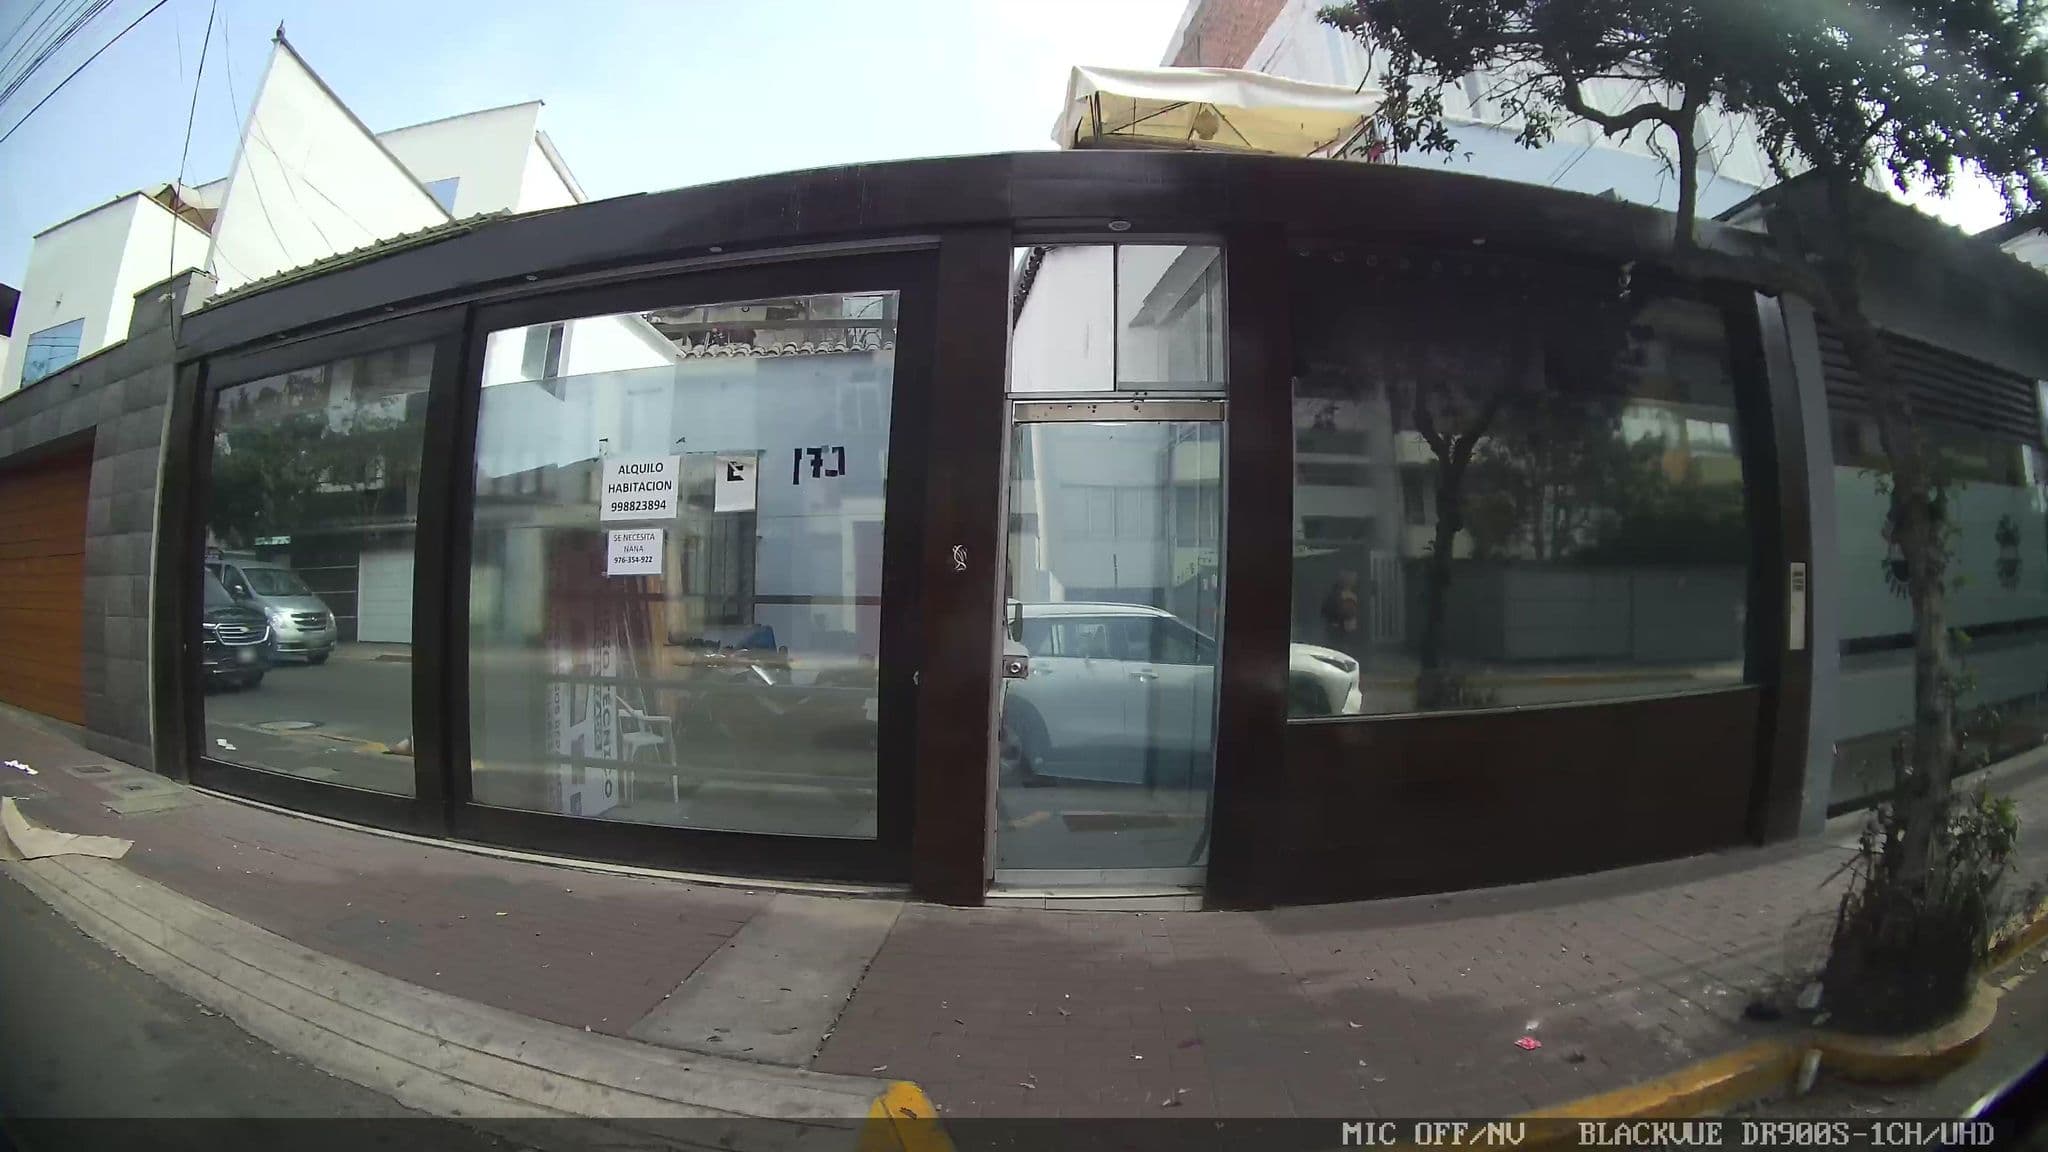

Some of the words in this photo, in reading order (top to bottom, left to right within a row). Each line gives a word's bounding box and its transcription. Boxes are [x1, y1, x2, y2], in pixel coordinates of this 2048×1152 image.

[618, 462, 664, 475] ALQUILO
[608, 480, 672, 493] HABITACION
[611, 500, 666, 512] 998823894
[613, 534, 622, 542] SE
[623, 533, 655, 541] NECESITA
[613, 556, 653, 564] 976-354-922
